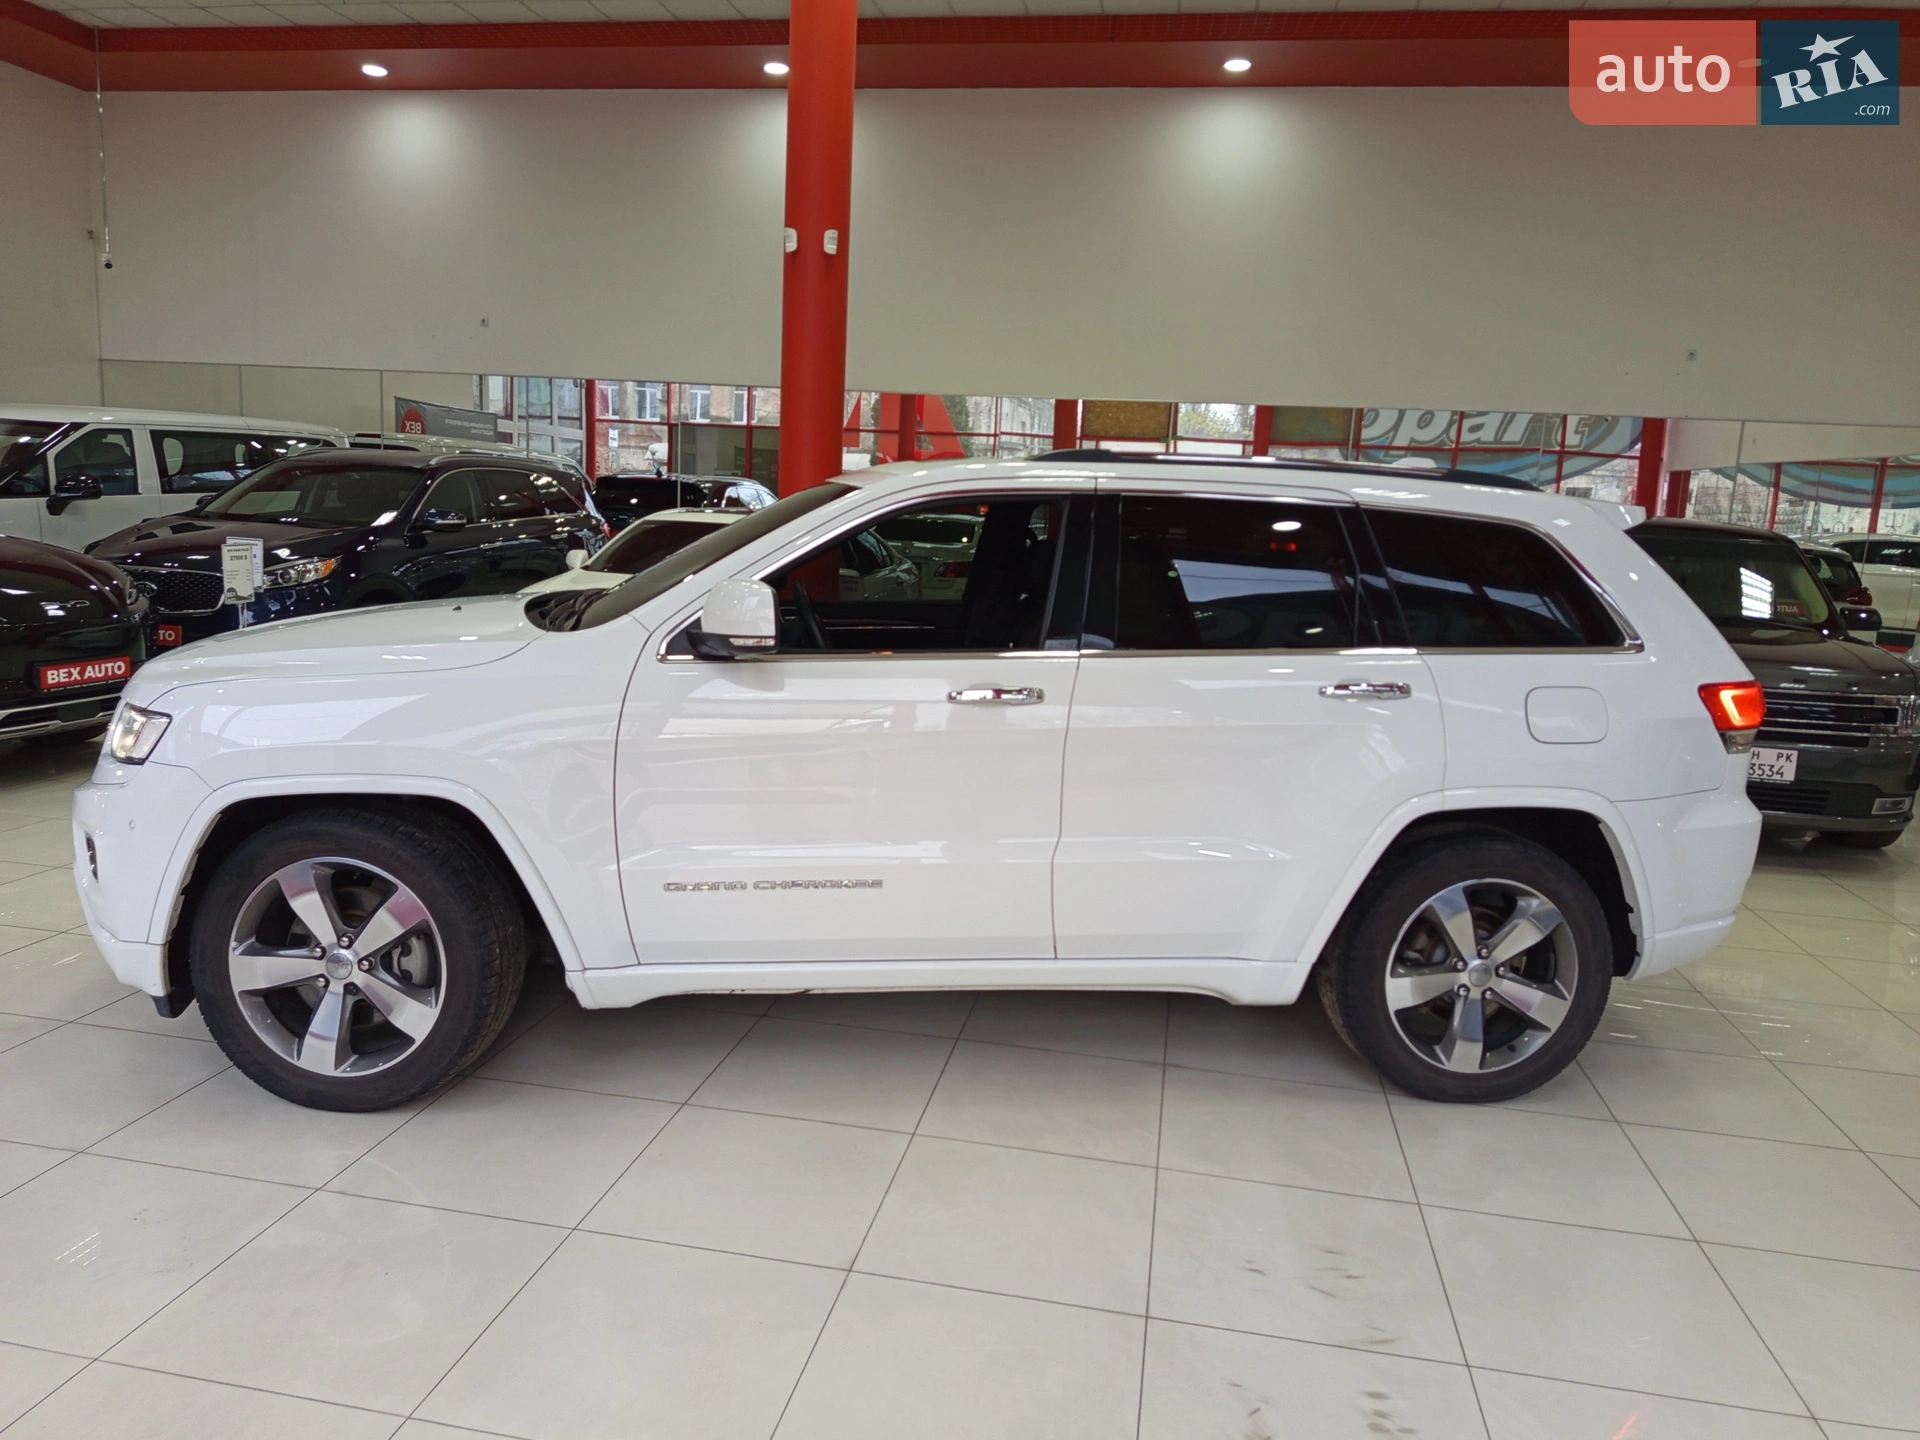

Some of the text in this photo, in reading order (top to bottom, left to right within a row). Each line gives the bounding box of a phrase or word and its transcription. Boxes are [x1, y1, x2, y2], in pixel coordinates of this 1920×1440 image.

[47, 661, 126, 684] BEX AUTO
[1776, 752, 1793, 763] PK
[1748, 762, 1784, 778] 3534
[664, 879, 883, 892] GRAND CHEROKEE
